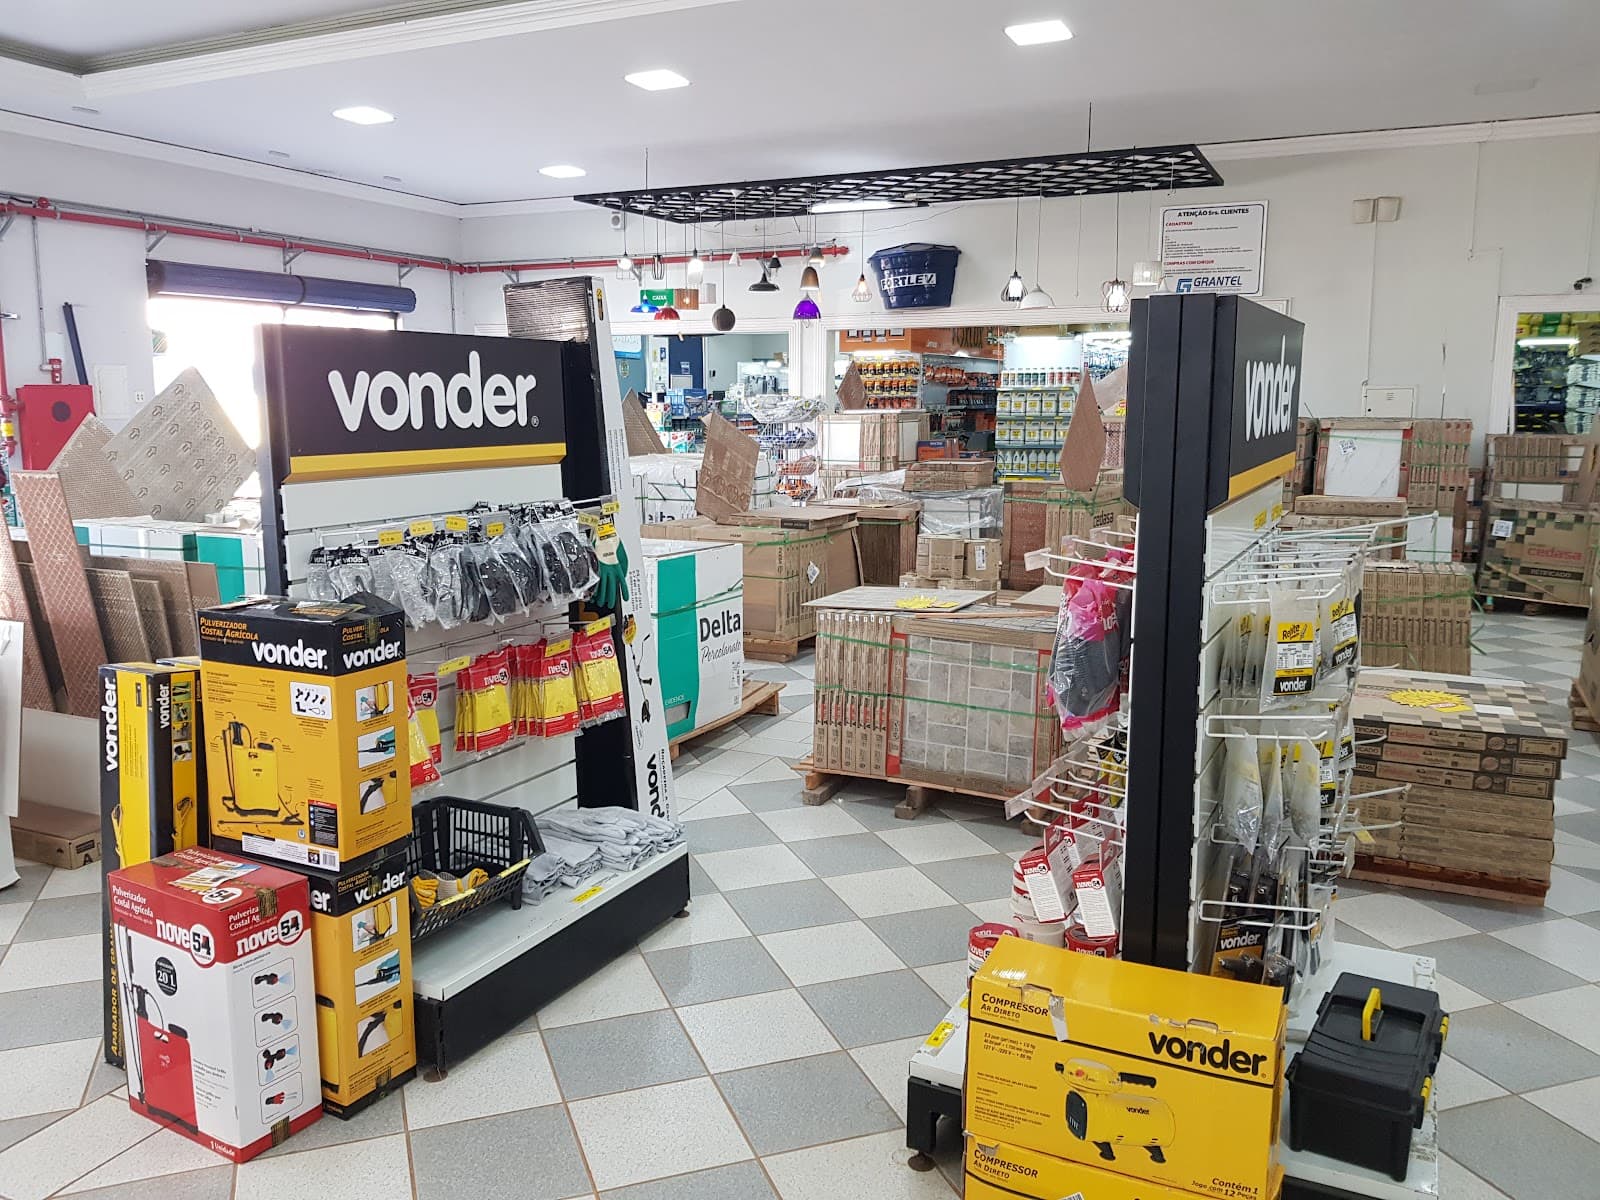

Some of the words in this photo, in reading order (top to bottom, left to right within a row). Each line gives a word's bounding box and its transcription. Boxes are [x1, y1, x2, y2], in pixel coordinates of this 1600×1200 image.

[1193, 276, 1243, 287] GRANTEL
[328, 350, 537, 432] vonder
[1245, 334, 1297, 442] vonder
[200, 617, 247, 630] PULVERIZADOR
[201, 626, 224, 637] COSTAL
[342, 624, 366, 635] PULVERI
[699, 609, 741, 643] Delta
[251, 639, 327, 670] vonder
[342, 639, 401, 669] vonder
[701, 639, 742, 664] Porcelanato
[1280, 677, 1307, 692] vonder
[156, 683, 170, 729] vonder
[101, 677, 118, 771] vonder
[647, 753, 665, 818] vond
[112, 885, 147, 905] Pulverizador
[113, 896, 130, 909] Costal
[131, 902, 154, 918] Agrícola
[229, 906, 259, 923] Pulveriza
[229, 916, 250, 931] Costal
[1220, 931, 1261, 950] vonder
[110, 967, 118, 985] DE
[980, 1003, 991, 1012] AR
[993, 1006, 1021, 1019] DIRETO
[981, 992, 1049, 1017] COMPRESSOR
[111, 989, 119, 1056] APARADOR
[1148, 1031, 1268, 1076] vonder
[1126, 1106, 1150, 1115] vonder
[974, 1149, 1039, 1178] COMPRESSOR
[984, 1165, 1010, 1179] DIRETO
[1212, 1177, 1251, 1193] Contém
[1224, 1189, 1236, 1197] 12
